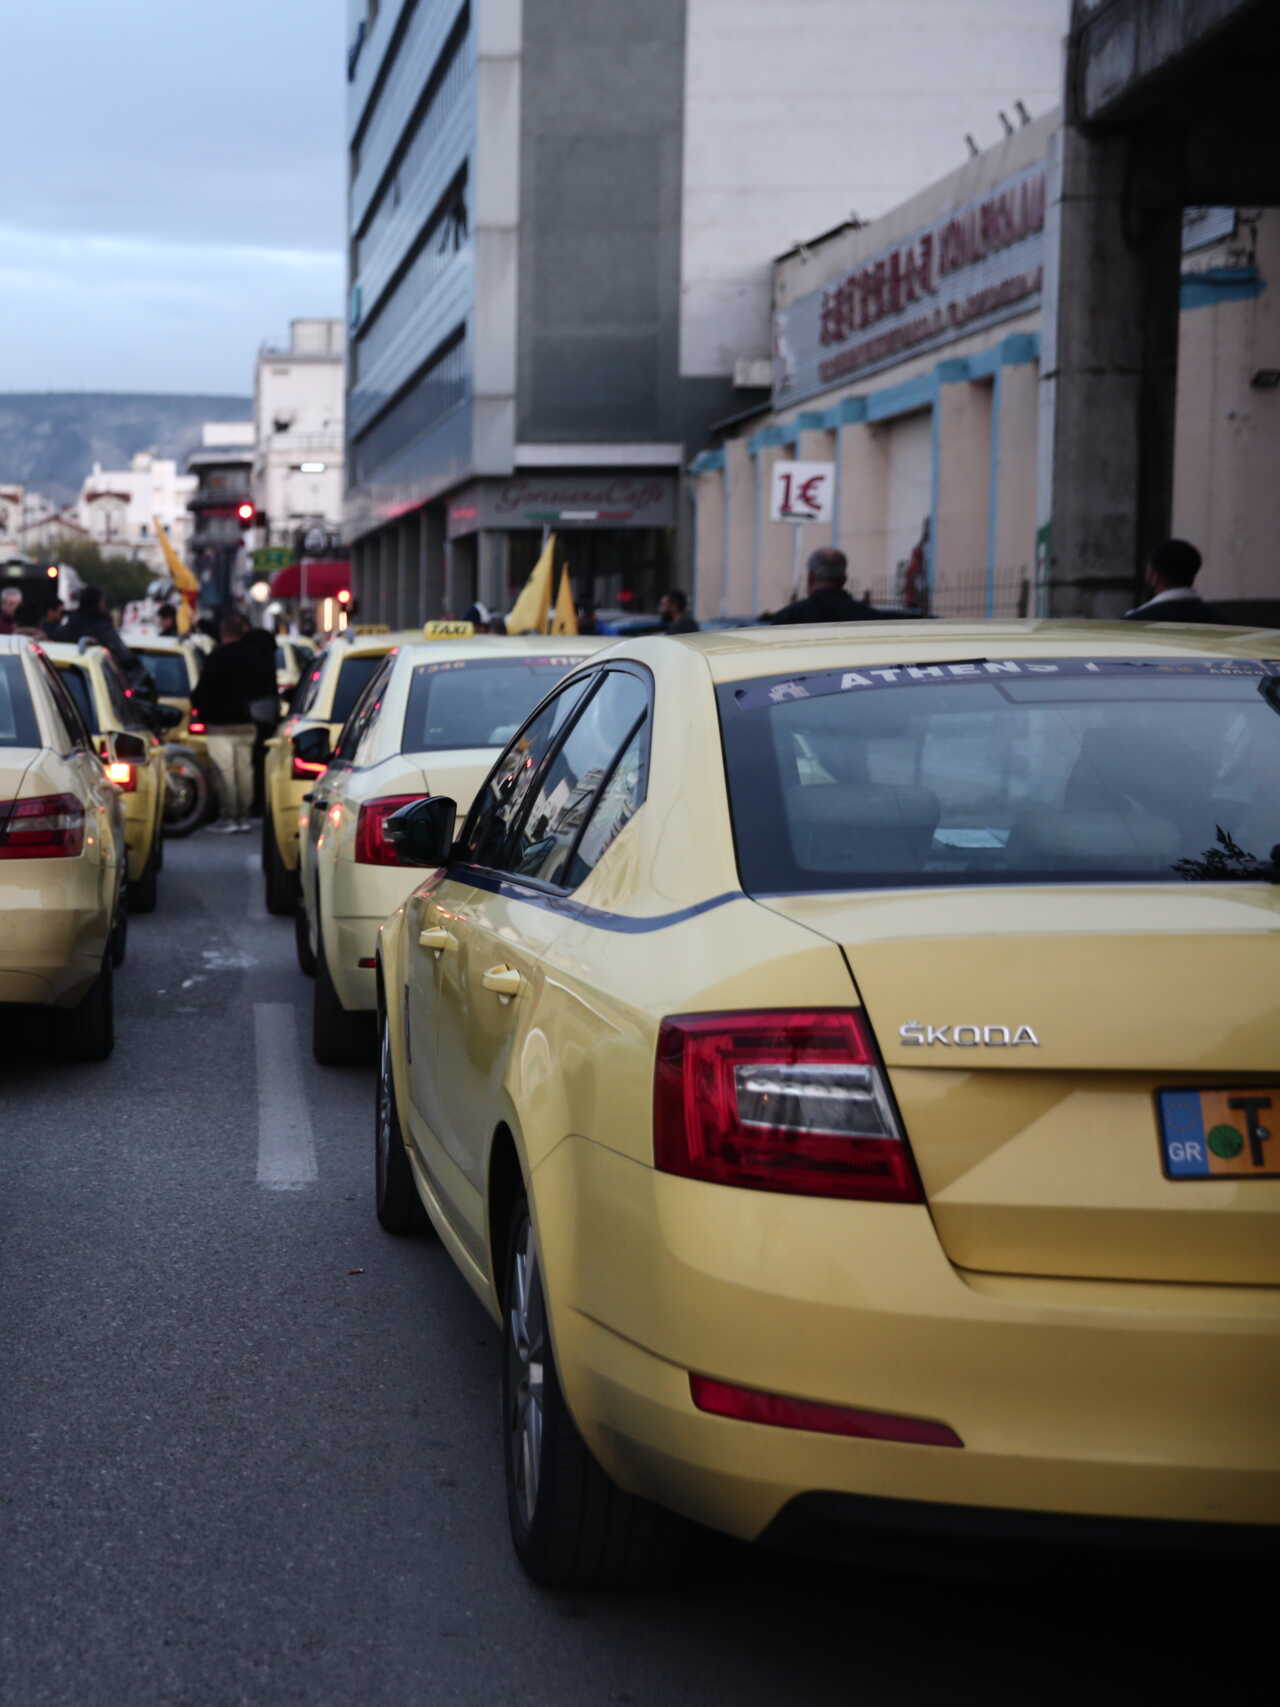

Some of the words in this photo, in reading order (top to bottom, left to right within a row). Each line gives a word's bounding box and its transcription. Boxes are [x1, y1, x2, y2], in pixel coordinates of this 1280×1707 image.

[778, 474, 825, 512] 1€
[431, 624, 467, 634] TAXI
[1168, 1141, 1202, 1161] GR
